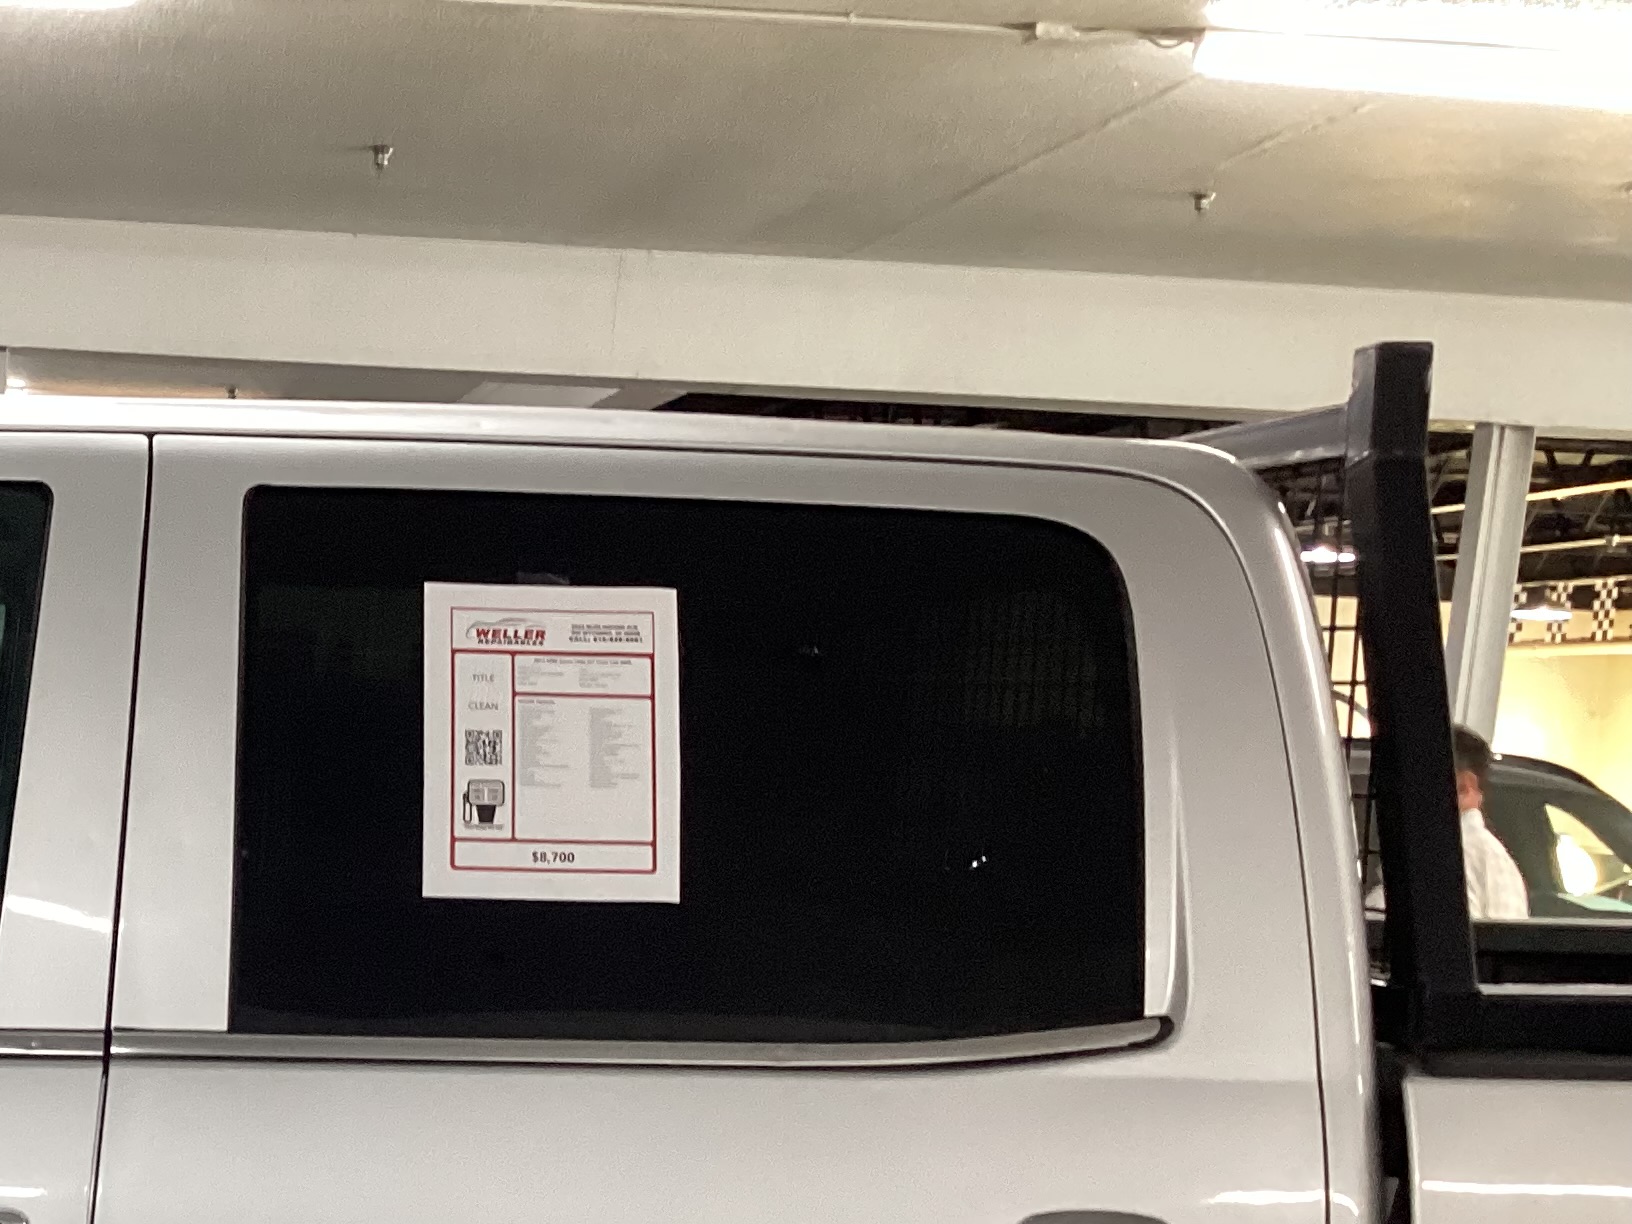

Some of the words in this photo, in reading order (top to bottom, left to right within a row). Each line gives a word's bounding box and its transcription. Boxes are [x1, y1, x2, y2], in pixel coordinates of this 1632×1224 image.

[475, 628, 546, 640] WELLER
[472, 673, 495, 682] TITLE
[468, 702, 499, 711] CLEAN
[532, 851, 575, 863] $8,700
